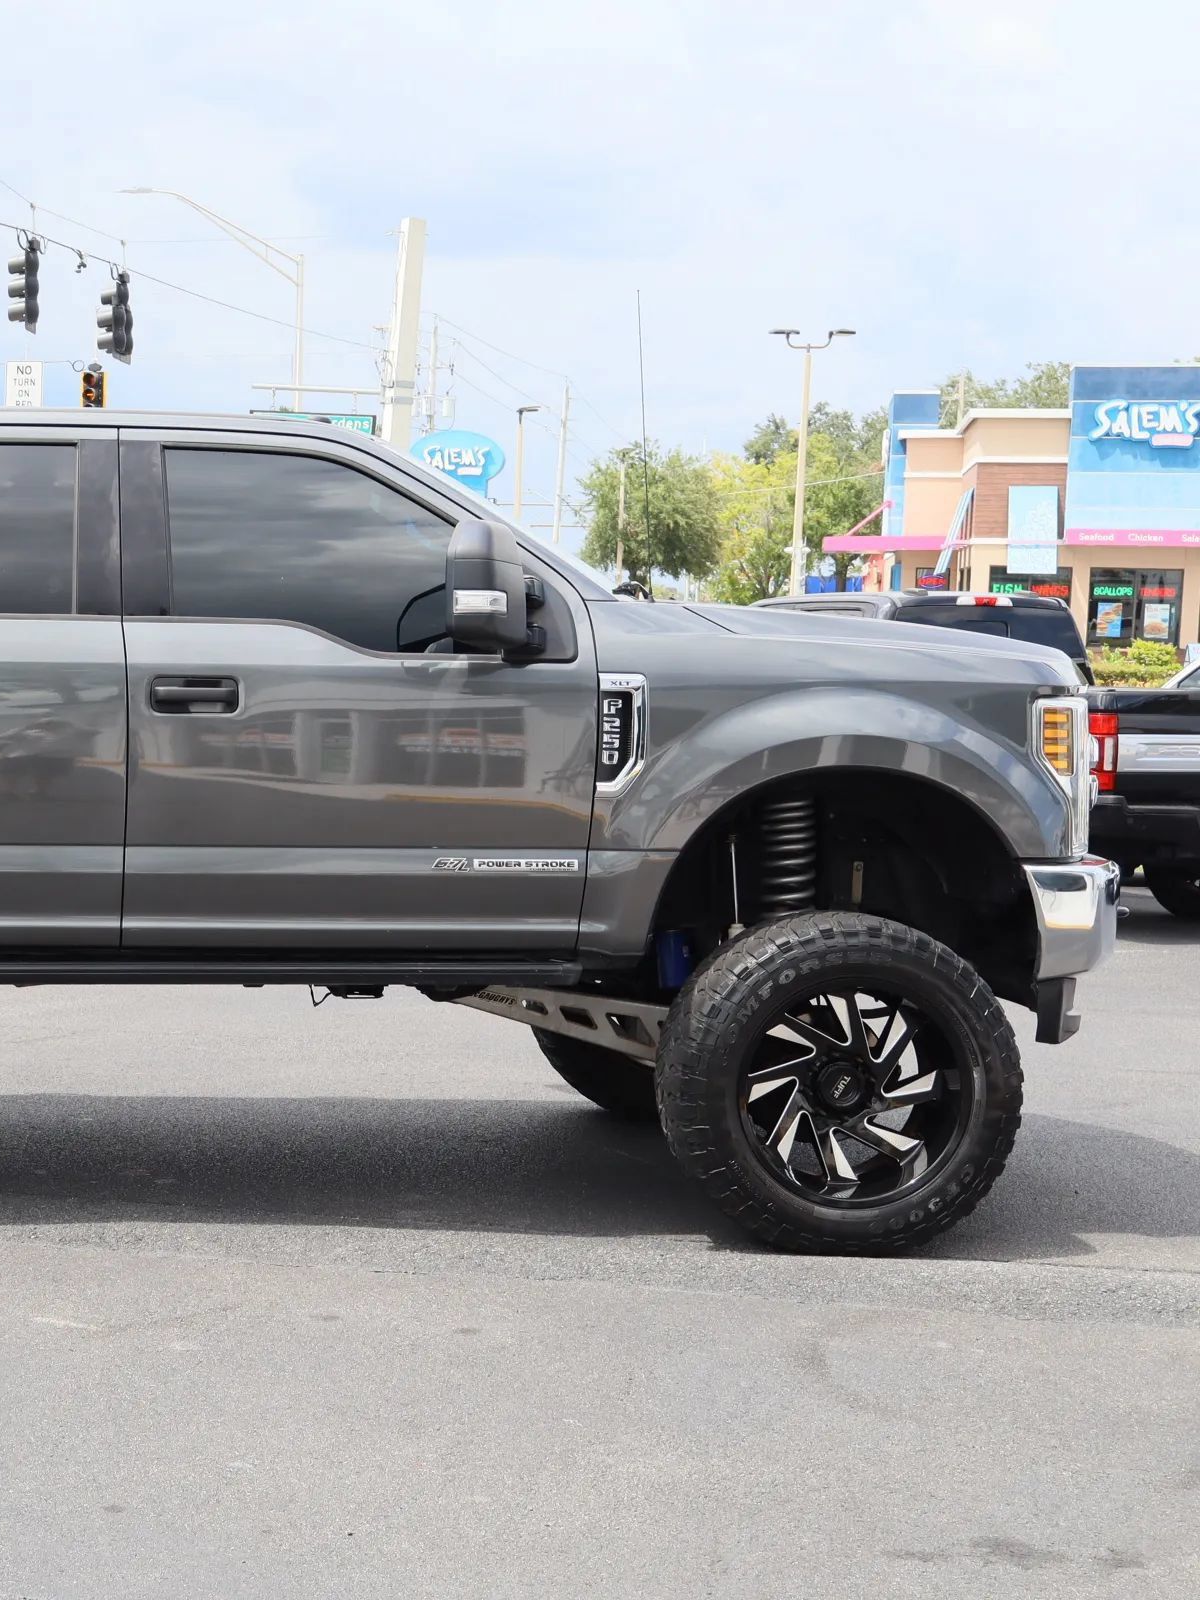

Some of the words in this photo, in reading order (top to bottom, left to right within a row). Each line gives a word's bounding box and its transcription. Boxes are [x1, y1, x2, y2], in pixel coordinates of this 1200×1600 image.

[16, 365, 32, 375] NO
[13, 378, 35, 386] TURN
[17, 389, 30, 397] ON
[331, 417, 370, 431] rdens
[1090, 399, 1200, 439] SALEM'S
[423, 445, 490, 471] SALEM'S
[1079, 532, 1115, 541] Seafood
[1128, 533, 1164, 542] Chicken
[1093, 586, 1133, 596] SCALLOPS
[478, 860, 522, 868] POWER
[525, 860, 575, 868] STROKE
